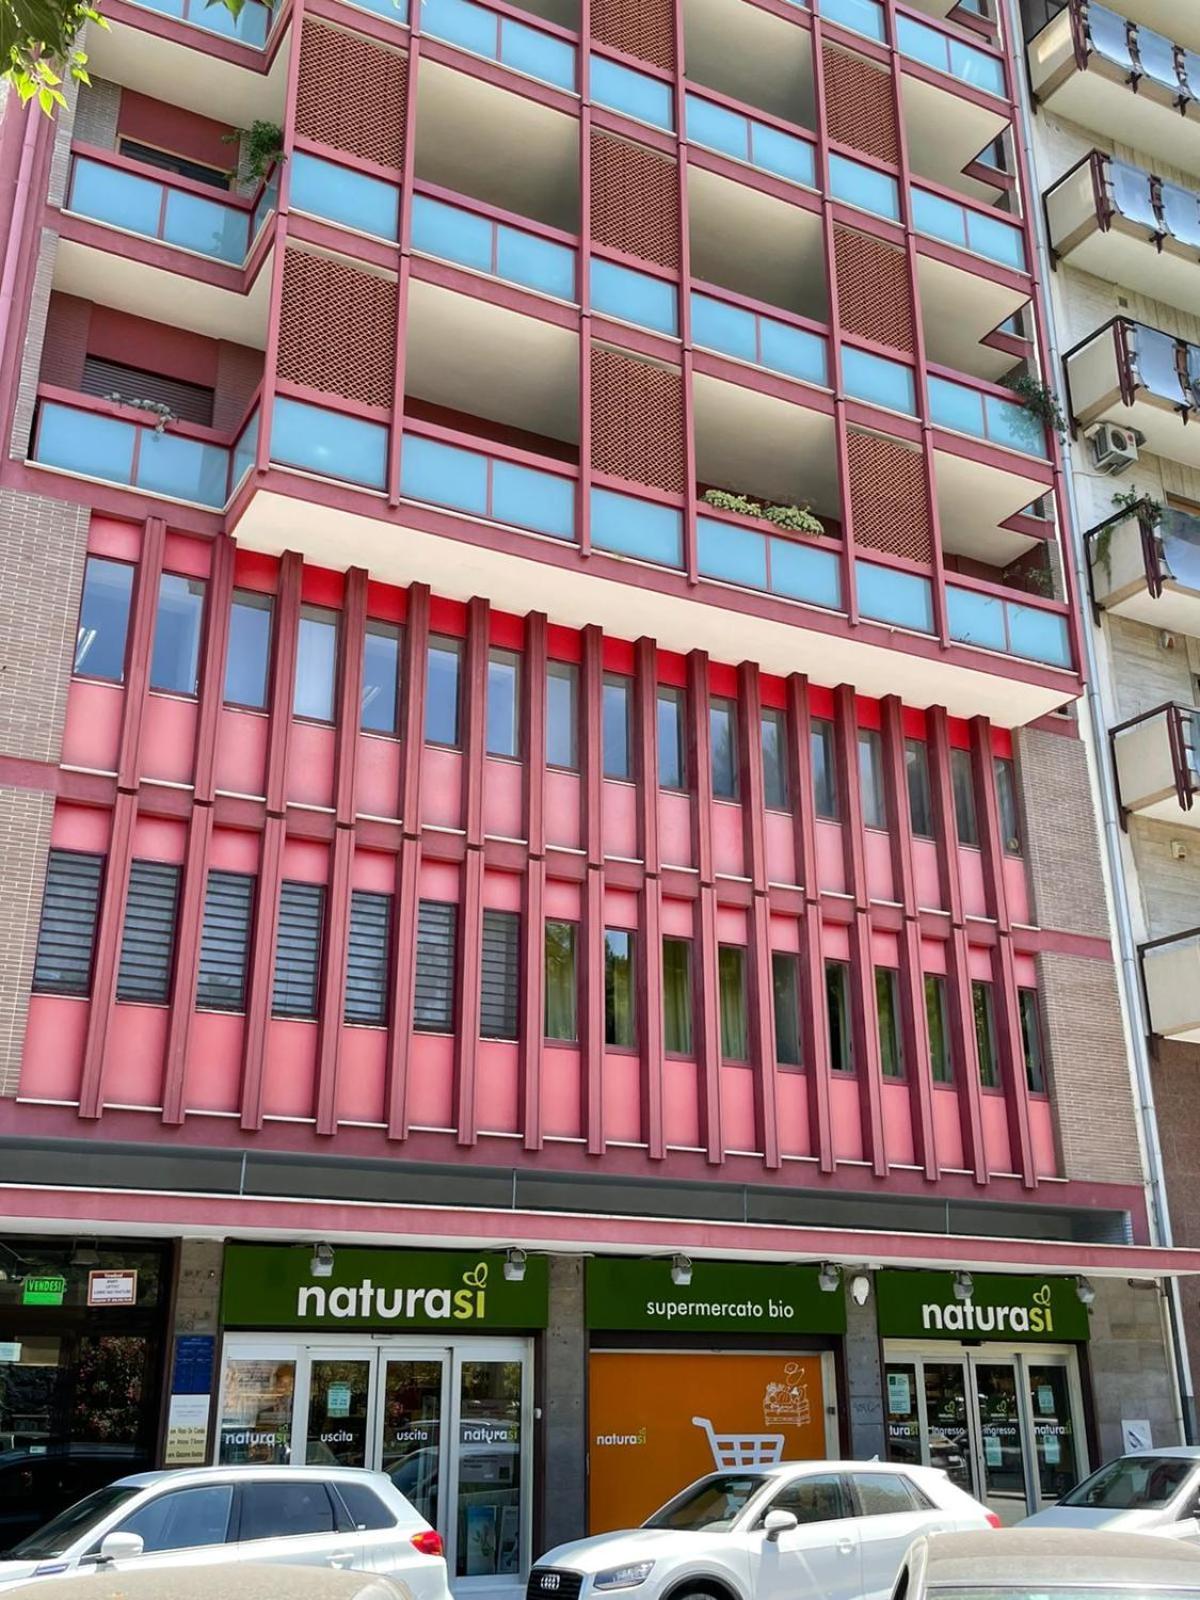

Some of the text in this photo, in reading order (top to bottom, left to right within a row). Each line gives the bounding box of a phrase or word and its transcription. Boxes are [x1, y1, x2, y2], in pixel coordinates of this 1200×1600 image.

[646, 1298, 795, 1320] supermercato bio
[320, 1430, 353, 1442] uscita
[396, 1429, 428, 1440] uscita
